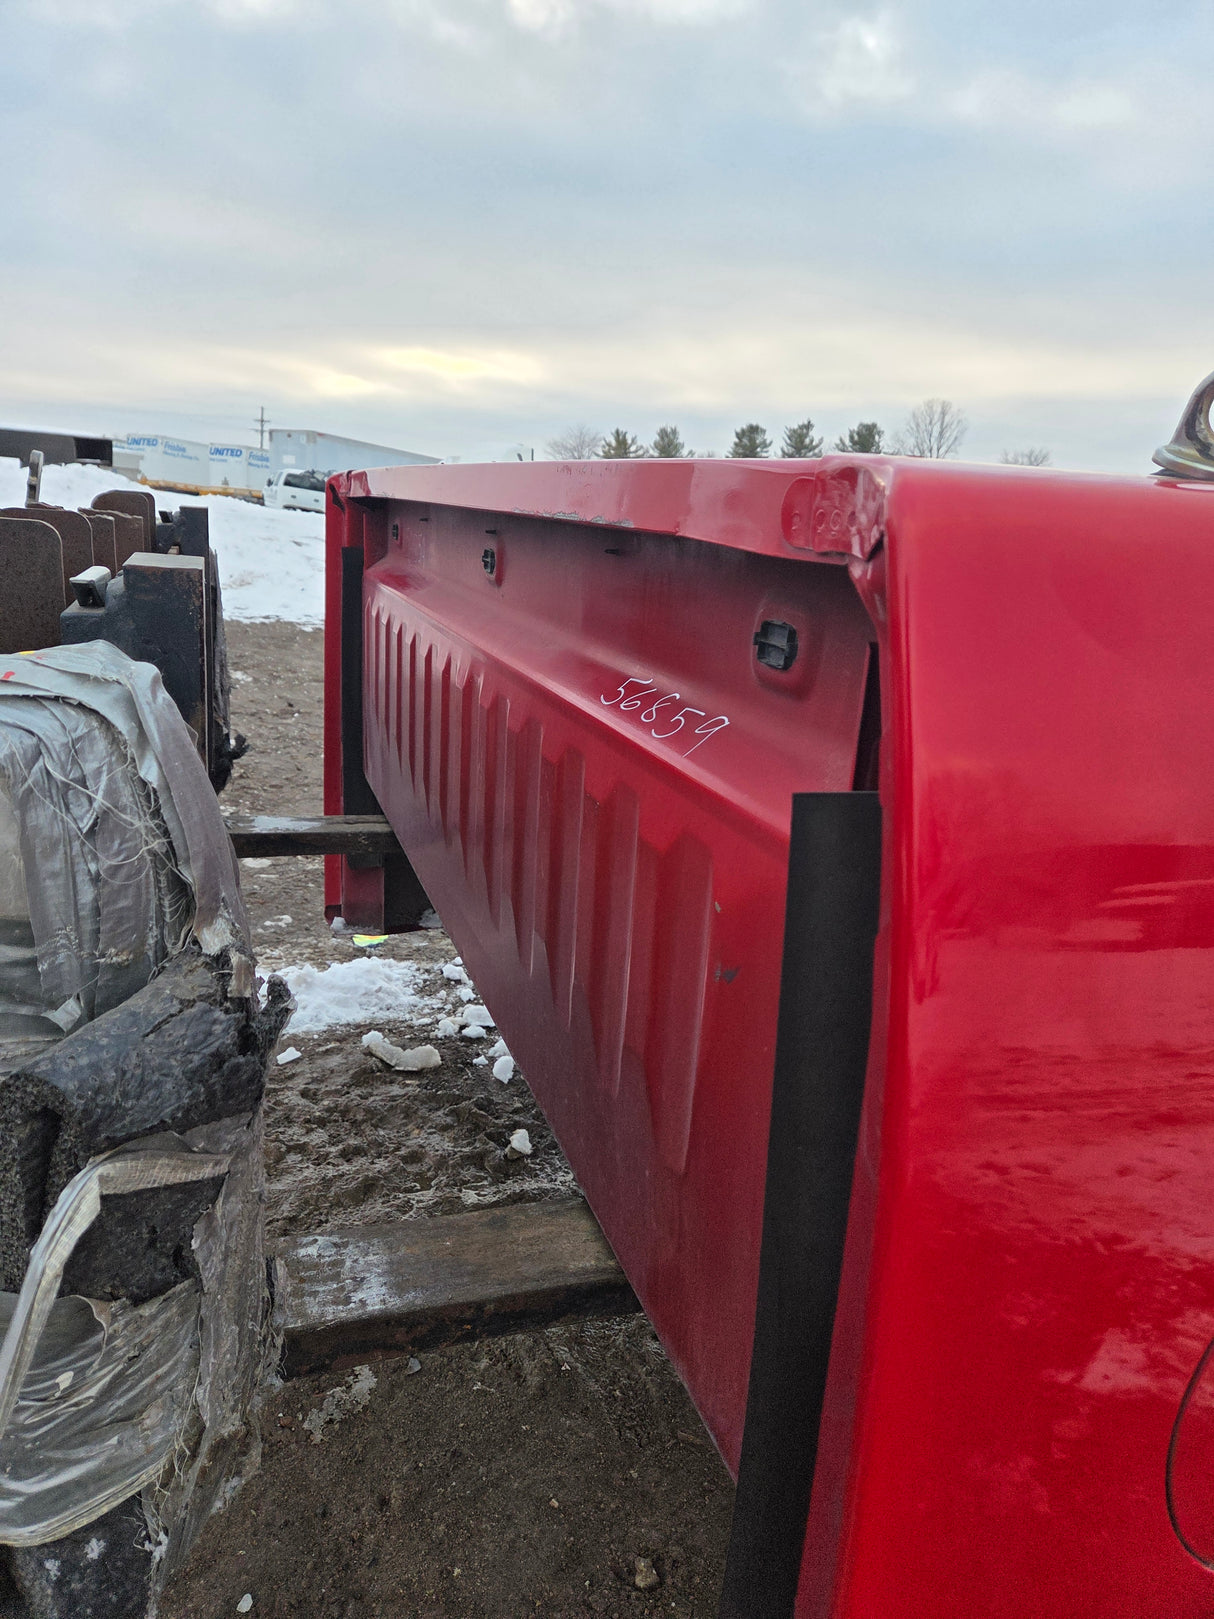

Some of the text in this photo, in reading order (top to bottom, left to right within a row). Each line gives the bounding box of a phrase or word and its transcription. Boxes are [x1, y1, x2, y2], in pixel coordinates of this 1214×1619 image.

[127, 437, 159, 447] UNITED
[209, 447, 243, 458] UNITED
[600, 677, 731, 758] 56859
